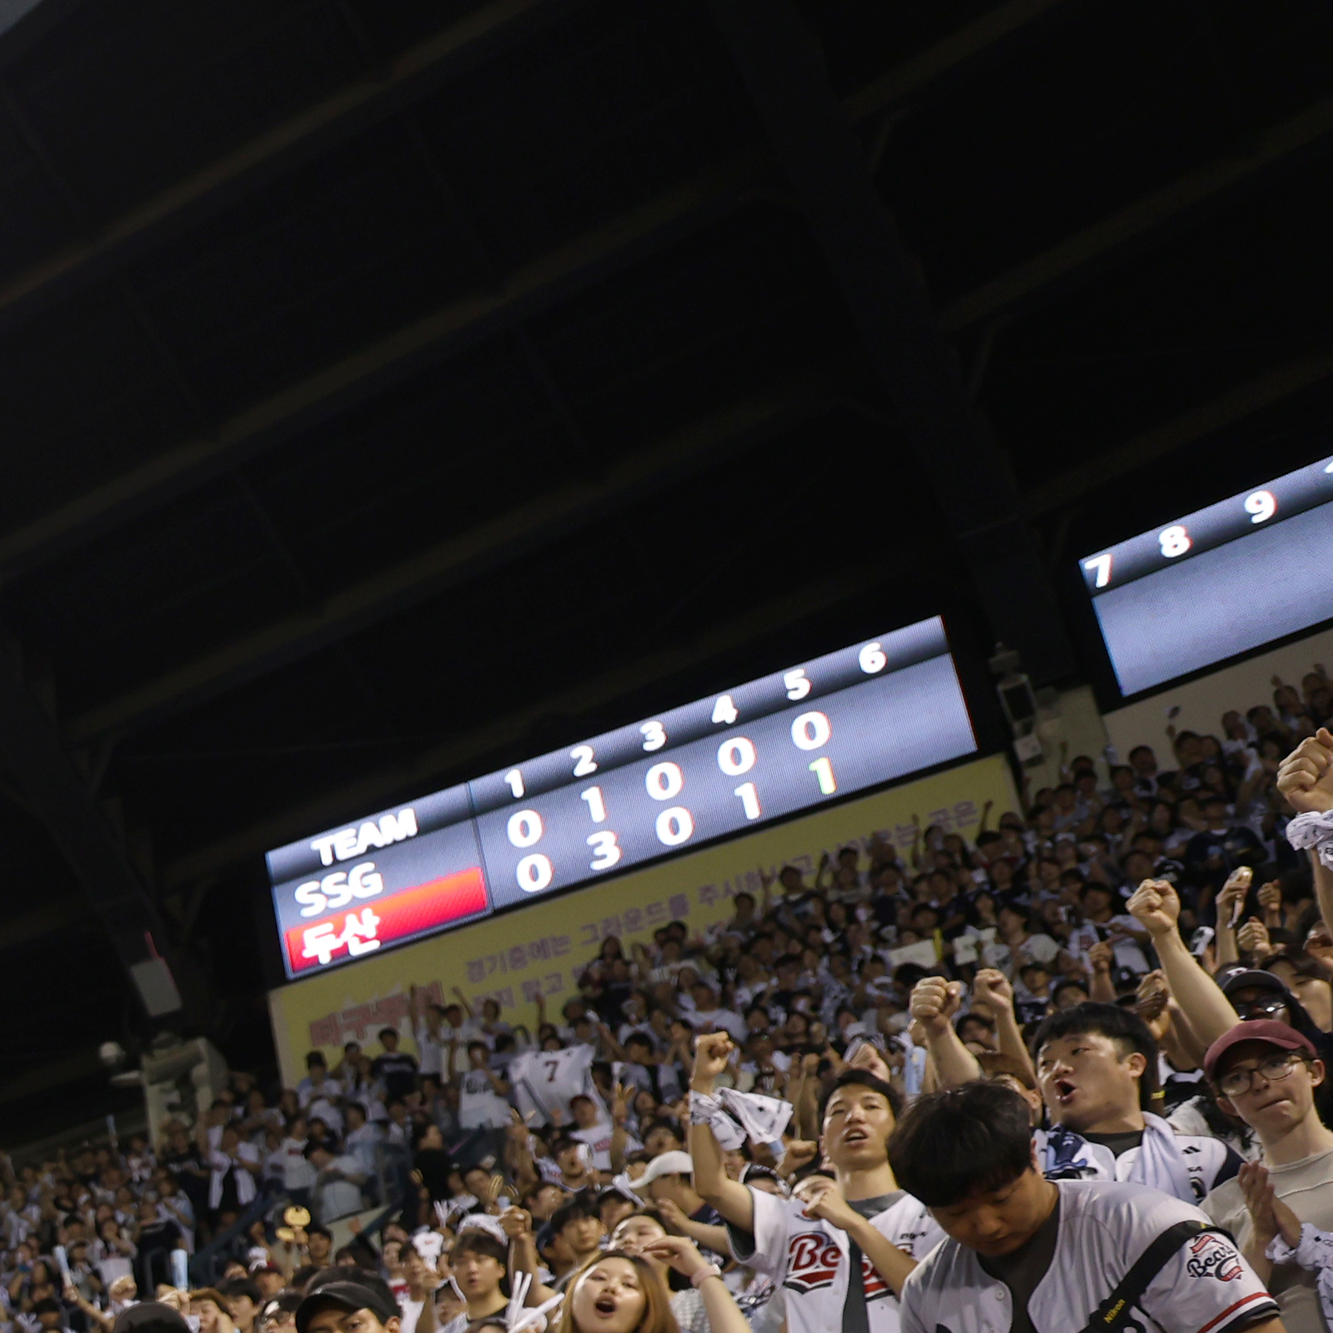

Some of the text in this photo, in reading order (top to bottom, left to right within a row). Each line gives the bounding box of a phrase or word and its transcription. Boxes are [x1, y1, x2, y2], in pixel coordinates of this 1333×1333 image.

[1085, 490, 1277, 588] 7 8 9
[295, 711, 831, 917] SSG 0 1 0 0 0
[310, 642, 887, 866] TEAM 1 2 3 4 5 6
[302, 757, 836, 964] 두산 0 3 0 1 1
[1103, 1298, 1126, 1324] Nikon
